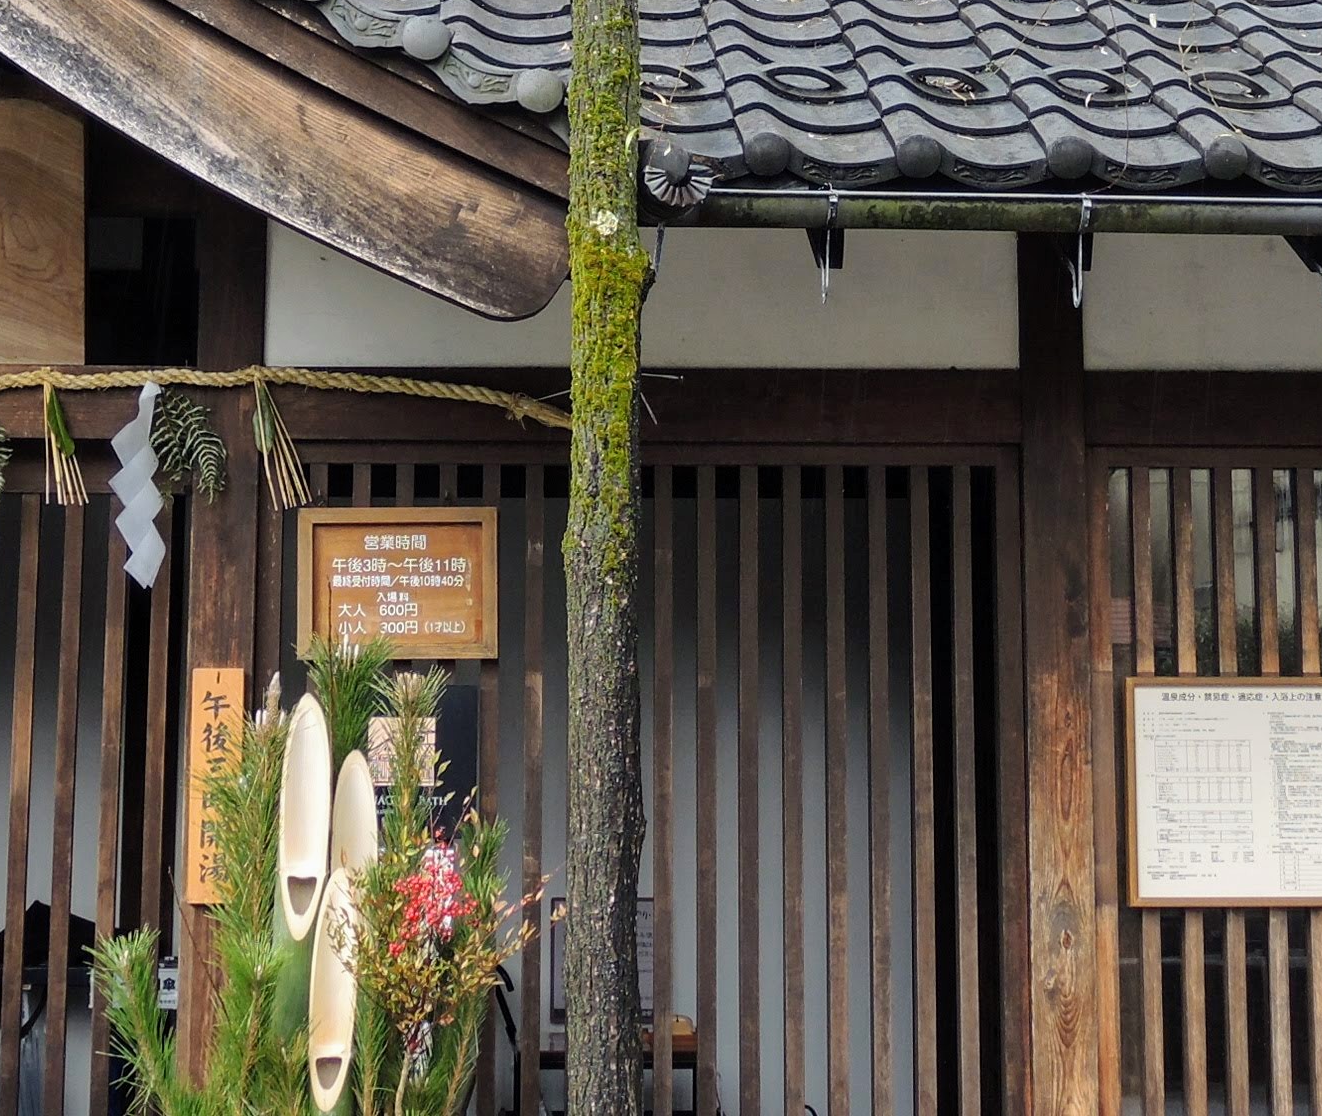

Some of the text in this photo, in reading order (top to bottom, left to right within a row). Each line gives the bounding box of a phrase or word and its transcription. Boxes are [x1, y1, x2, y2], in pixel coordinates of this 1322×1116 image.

[363, 534, 427, 550] 営業時間
[338, 603, 418, 617] 大人 600円
[338, 620, 367, 634] 小人
[379, 620, 418, 634] 300円
